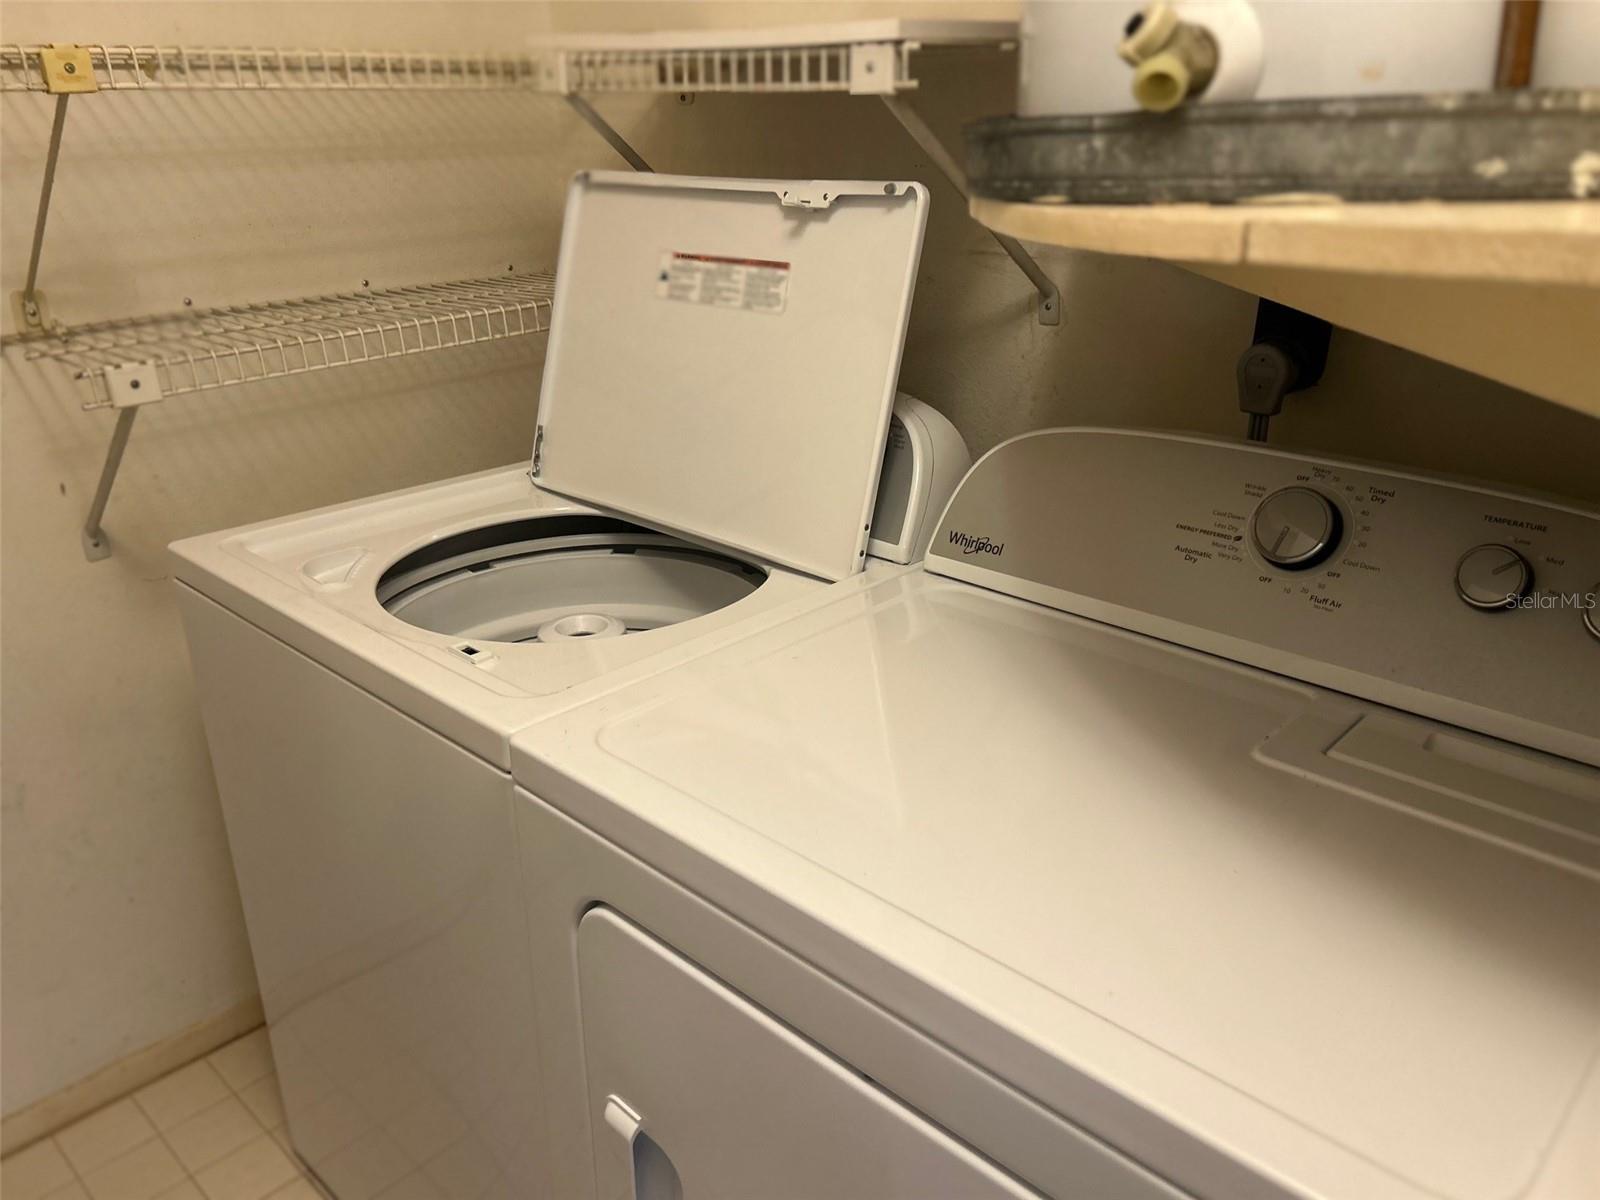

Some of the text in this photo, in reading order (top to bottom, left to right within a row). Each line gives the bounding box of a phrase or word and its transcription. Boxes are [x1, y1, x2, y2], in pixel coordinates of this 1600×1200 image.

[1368, 486, 1396, 498] Timed
[1370, 495, 1387, 504] Dry
[1227, 524, 1239, 533] Dry
[1483, 514, 1548, 533] TEMPERATURE
[1176, 523, 1232, 540] ENERGY PREFERRED
[949, 530, 1004, 557] Whirlpool
[1174, 544, 1213, 560] Automatic
[1184, 554, 1198, 564] Dry
[1232, 554, 1243, 563] Dry
[1342, 558, 1358, 568] Cool
[1258, 575, 1272, 584] OFF
[1327, 570, 1341, 579] OFF
[1308, 594, 1343, 609] Fluff Air
